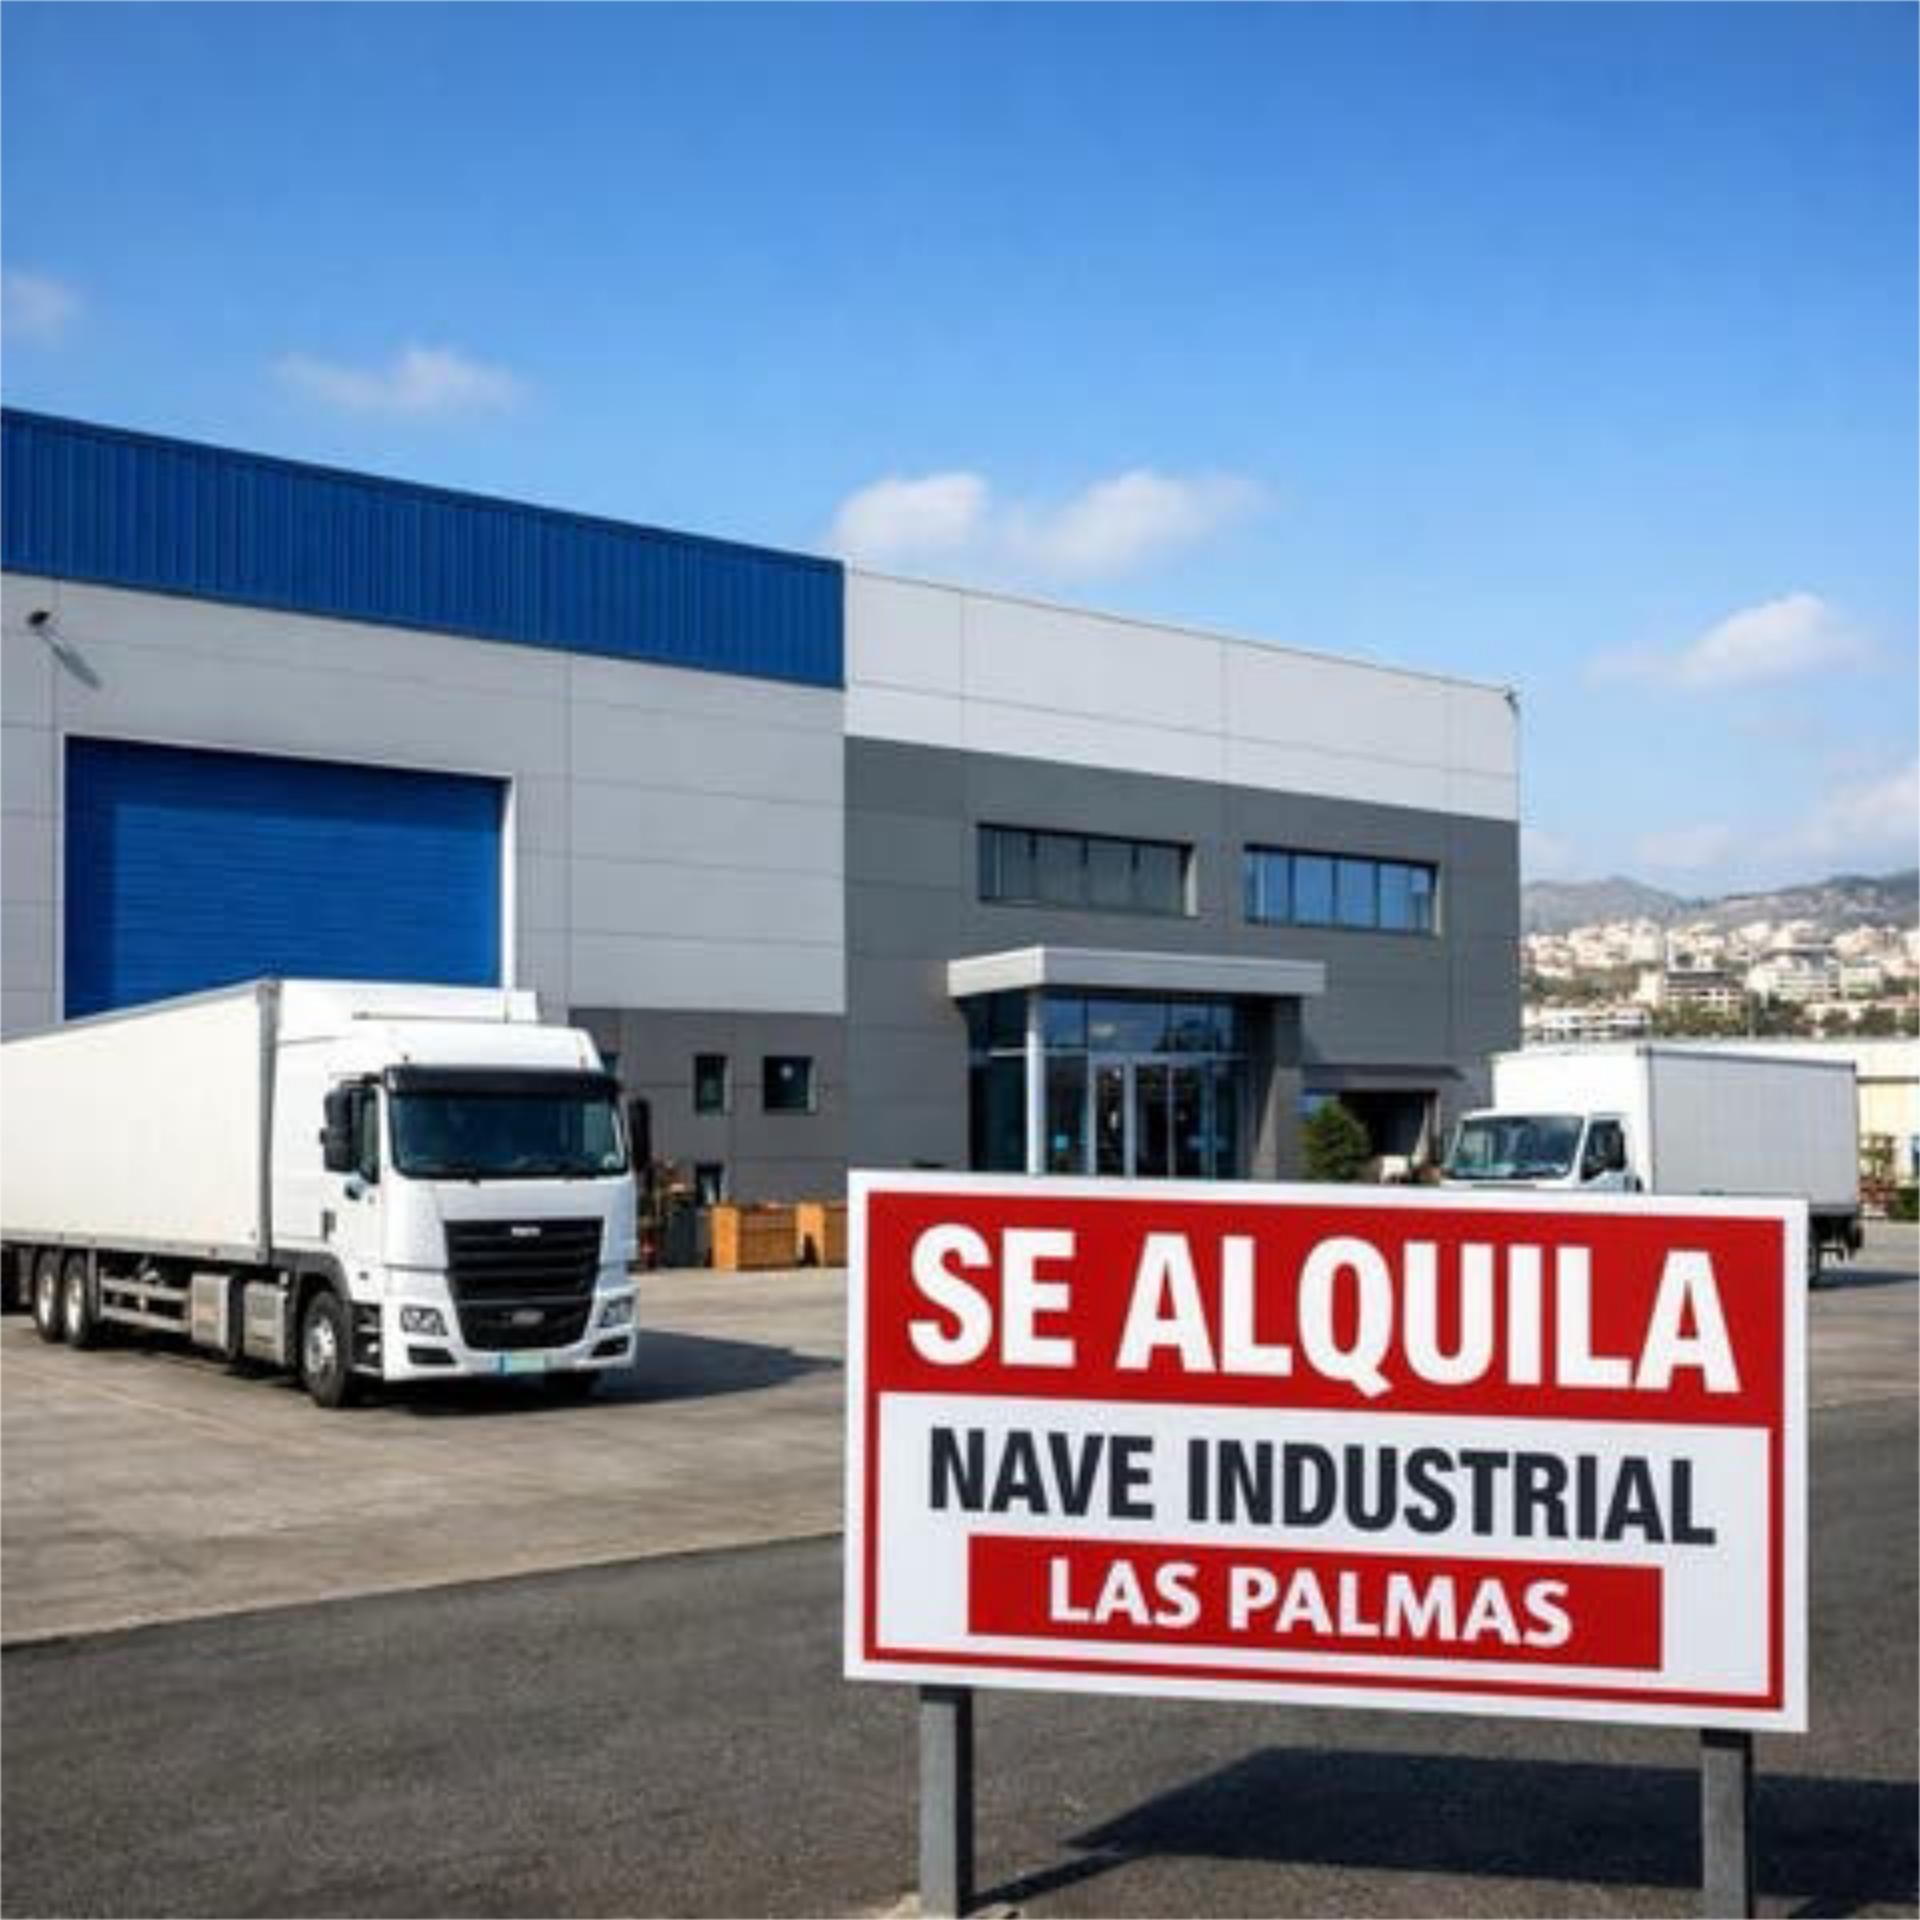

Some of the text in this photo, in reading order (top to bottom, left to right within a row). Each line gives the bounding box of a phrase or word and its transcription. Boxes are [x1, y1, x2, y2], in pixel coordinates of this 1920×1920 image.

[908, 1223, 1741, 1398] SE ALQUILA
[930, 1427, 1717, 1547] NAVE INDUSTRIAL
[1050, 1557, 1572, 1649] LAS PALMAS
